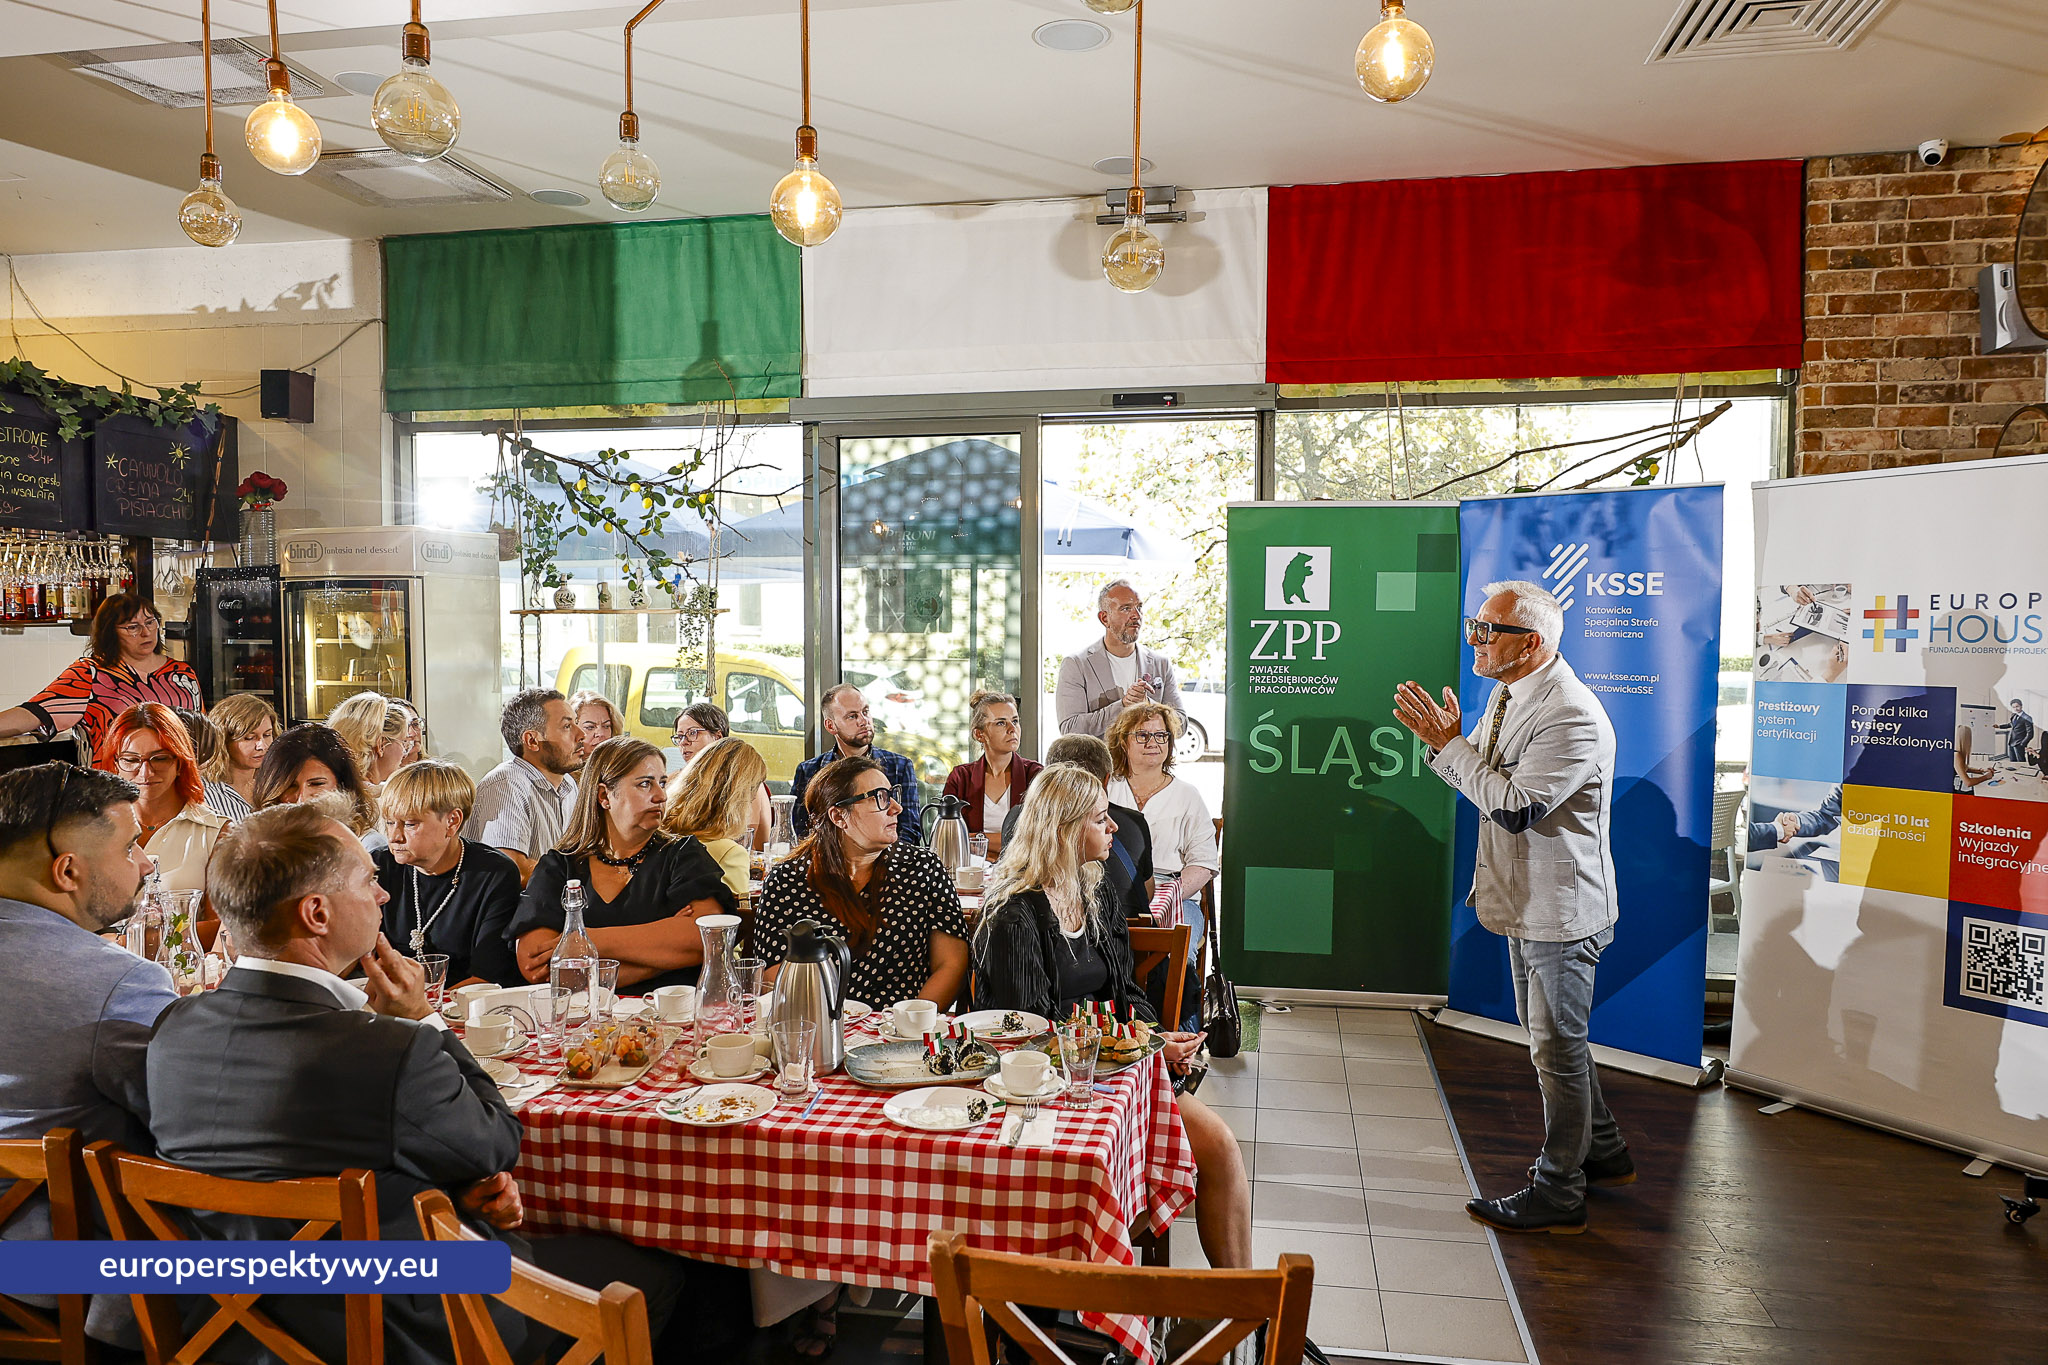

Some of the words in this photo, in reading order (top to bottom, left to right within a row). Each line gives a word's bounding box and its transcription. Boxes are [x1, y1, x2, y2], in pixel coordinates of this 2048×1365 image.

[118, 457, 183, 486] CANNOLO
[17, 473, 36, 484] con
[38, 473, 61, 488] pesto
[105, 476, 160, 497] CREMA
[116, 497, 195, 520] PISTACCHIO
[289, 544, 318, 559] bindi
[355, 546, 367, 554] nel
[369, 546, 399, 554] dessert
[426, 544, 449, 559] bindi
[1586, 572, 1664, 596] KSSE
[1930, 592, 2042, 610] EUROP
[1585, 606, 1632, 615] Katowicka
[1584, 618, 1629, 628] Specjalna
[1630, 618, 1659, 627] Strefa
[1929, 614, 2043, 644] HOUS
[1249, 620, 1342, 661] ZPP
[1584, 629, 1644, 639] Ekonomiczna
[1249, 665, 1290, 675] ZWIĄZEK
[1249, 675, 1339, 685] PRZEDSIĘBIORCÓW
[1584, 672, 1660, 684] www.ksse.com.pl
[1249, 685, 1252, 694] I
[1255, 685, 1336, 695] PRACODAWCÓW
[1758, 701, 1820, 716] Prestiżowy
[1851, 705, 1895, 717] Ponad
[1898, 707, 1928, 718] kilka
[1757, 715, 1796, 726] system
[1850, 719, 1902, 734] tysięcy
[1757, 728, 1817, 743] certyfikacji
[1850, 735, 1953, 751] przeszkolonych
[1848, 810, 1890, 823] Ponad
[1894, 814, 1908, 825] 10
[1911, 815, 1930, 828] lat
[1847, 824, 1926, 842] działalności
[1959, 821, 2032, 840] Szkolenia
[1958, 836, 2019, 857] Wyjazdy
[1958, 851, 2048, 875] integracyjne
